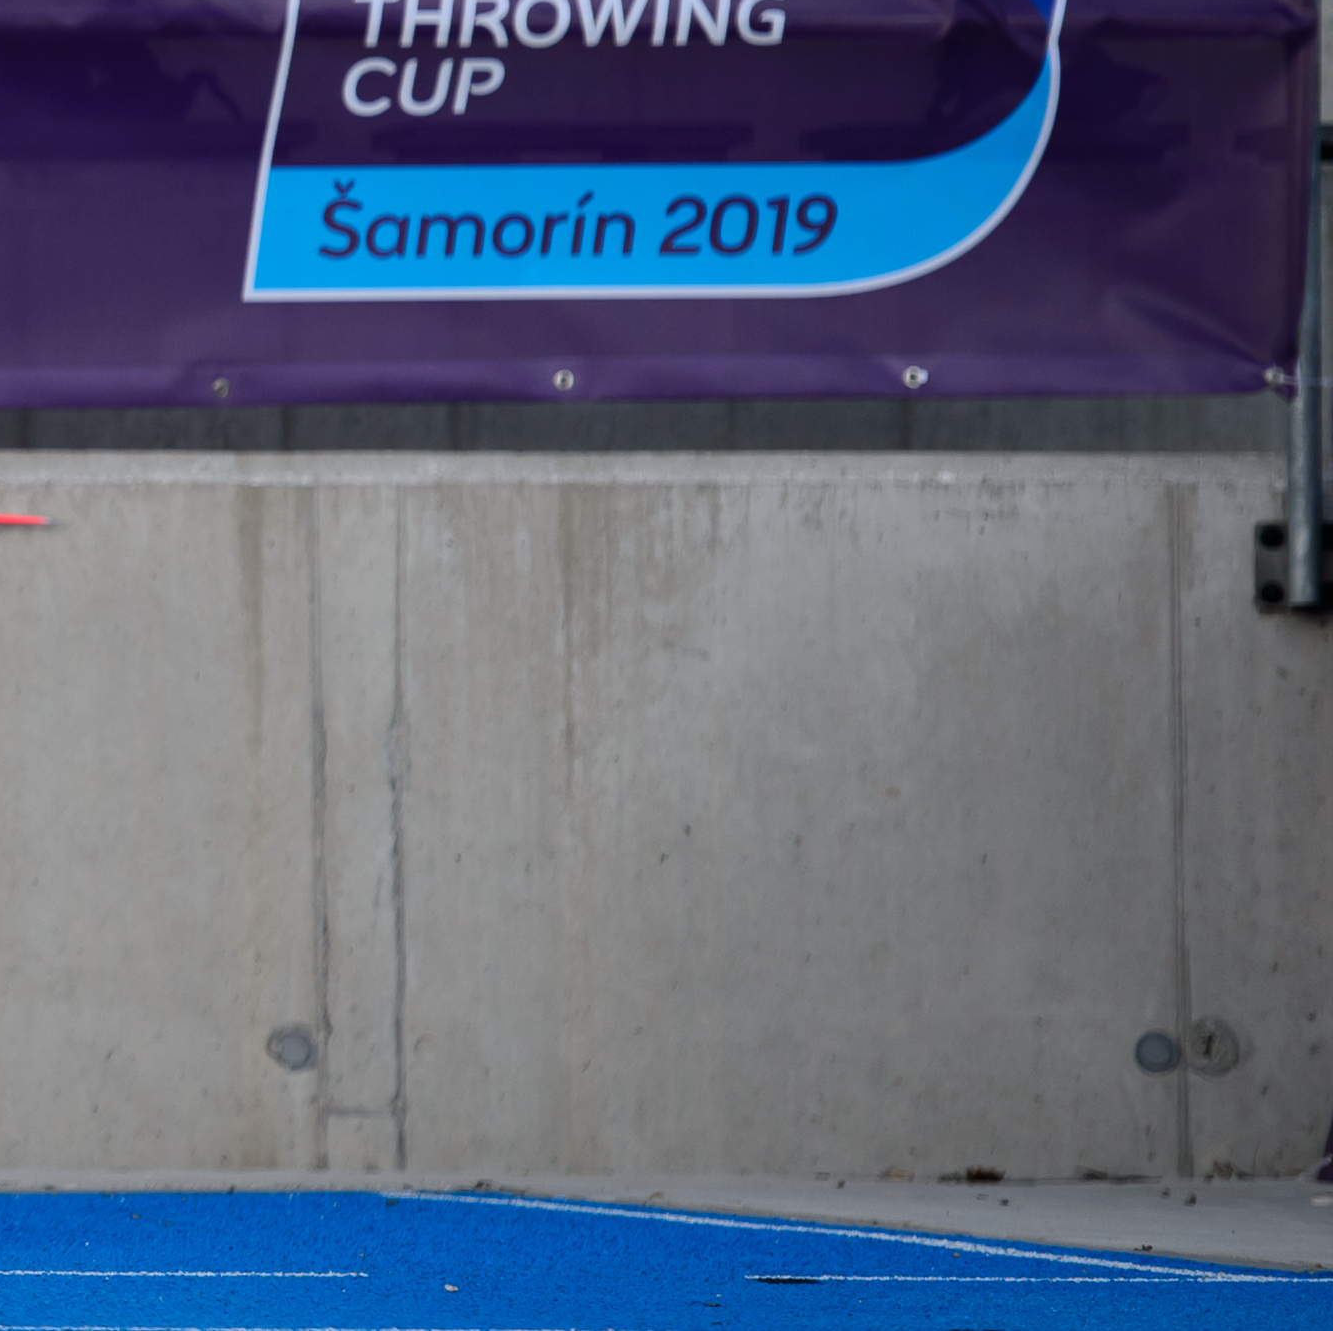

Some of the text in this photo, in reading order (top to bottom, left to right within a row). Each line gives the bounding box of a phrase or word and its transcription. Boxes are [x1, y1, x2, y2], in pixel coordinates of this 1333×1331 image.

[342, 57, 505, 117] CUP
[318, 180, 838, 259] Šamorín 2019
